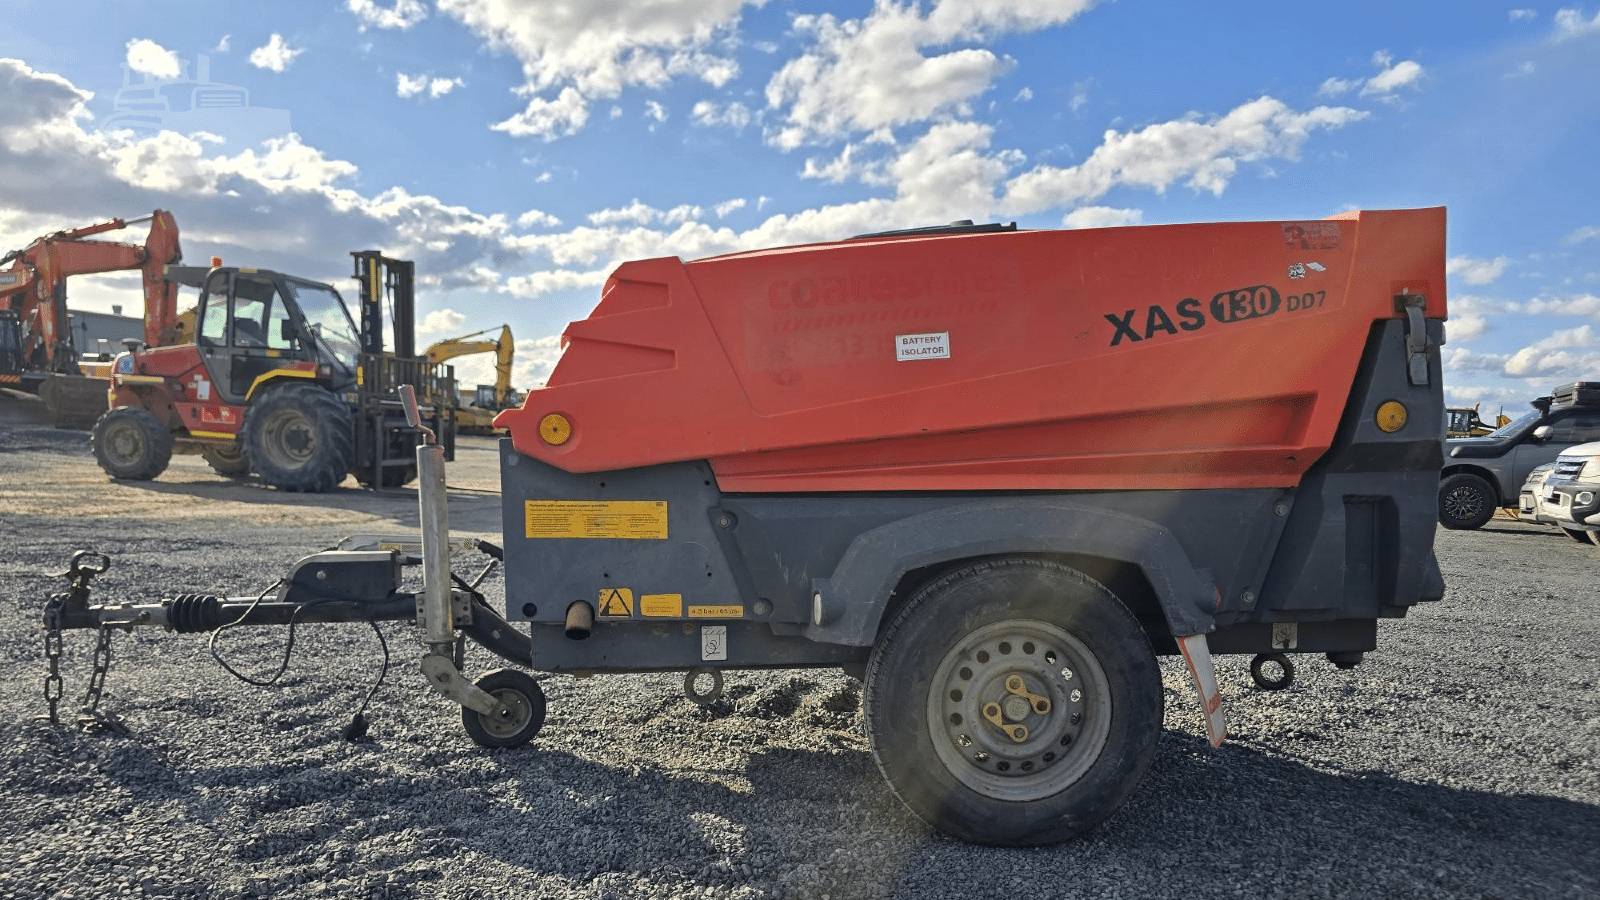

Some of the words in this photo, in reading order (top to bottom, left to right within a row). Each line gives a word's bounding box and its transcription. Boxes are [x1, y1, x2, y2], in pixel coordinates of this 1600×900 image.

[1104, 298, 1206, 347] XAS
[1216, 285, 1273, 322] 130
[1287, 290, 1327, 313] DD7
[902, 336, 942, 345] BATTERY
[901, 346, 945, 356] ISOLATOR
